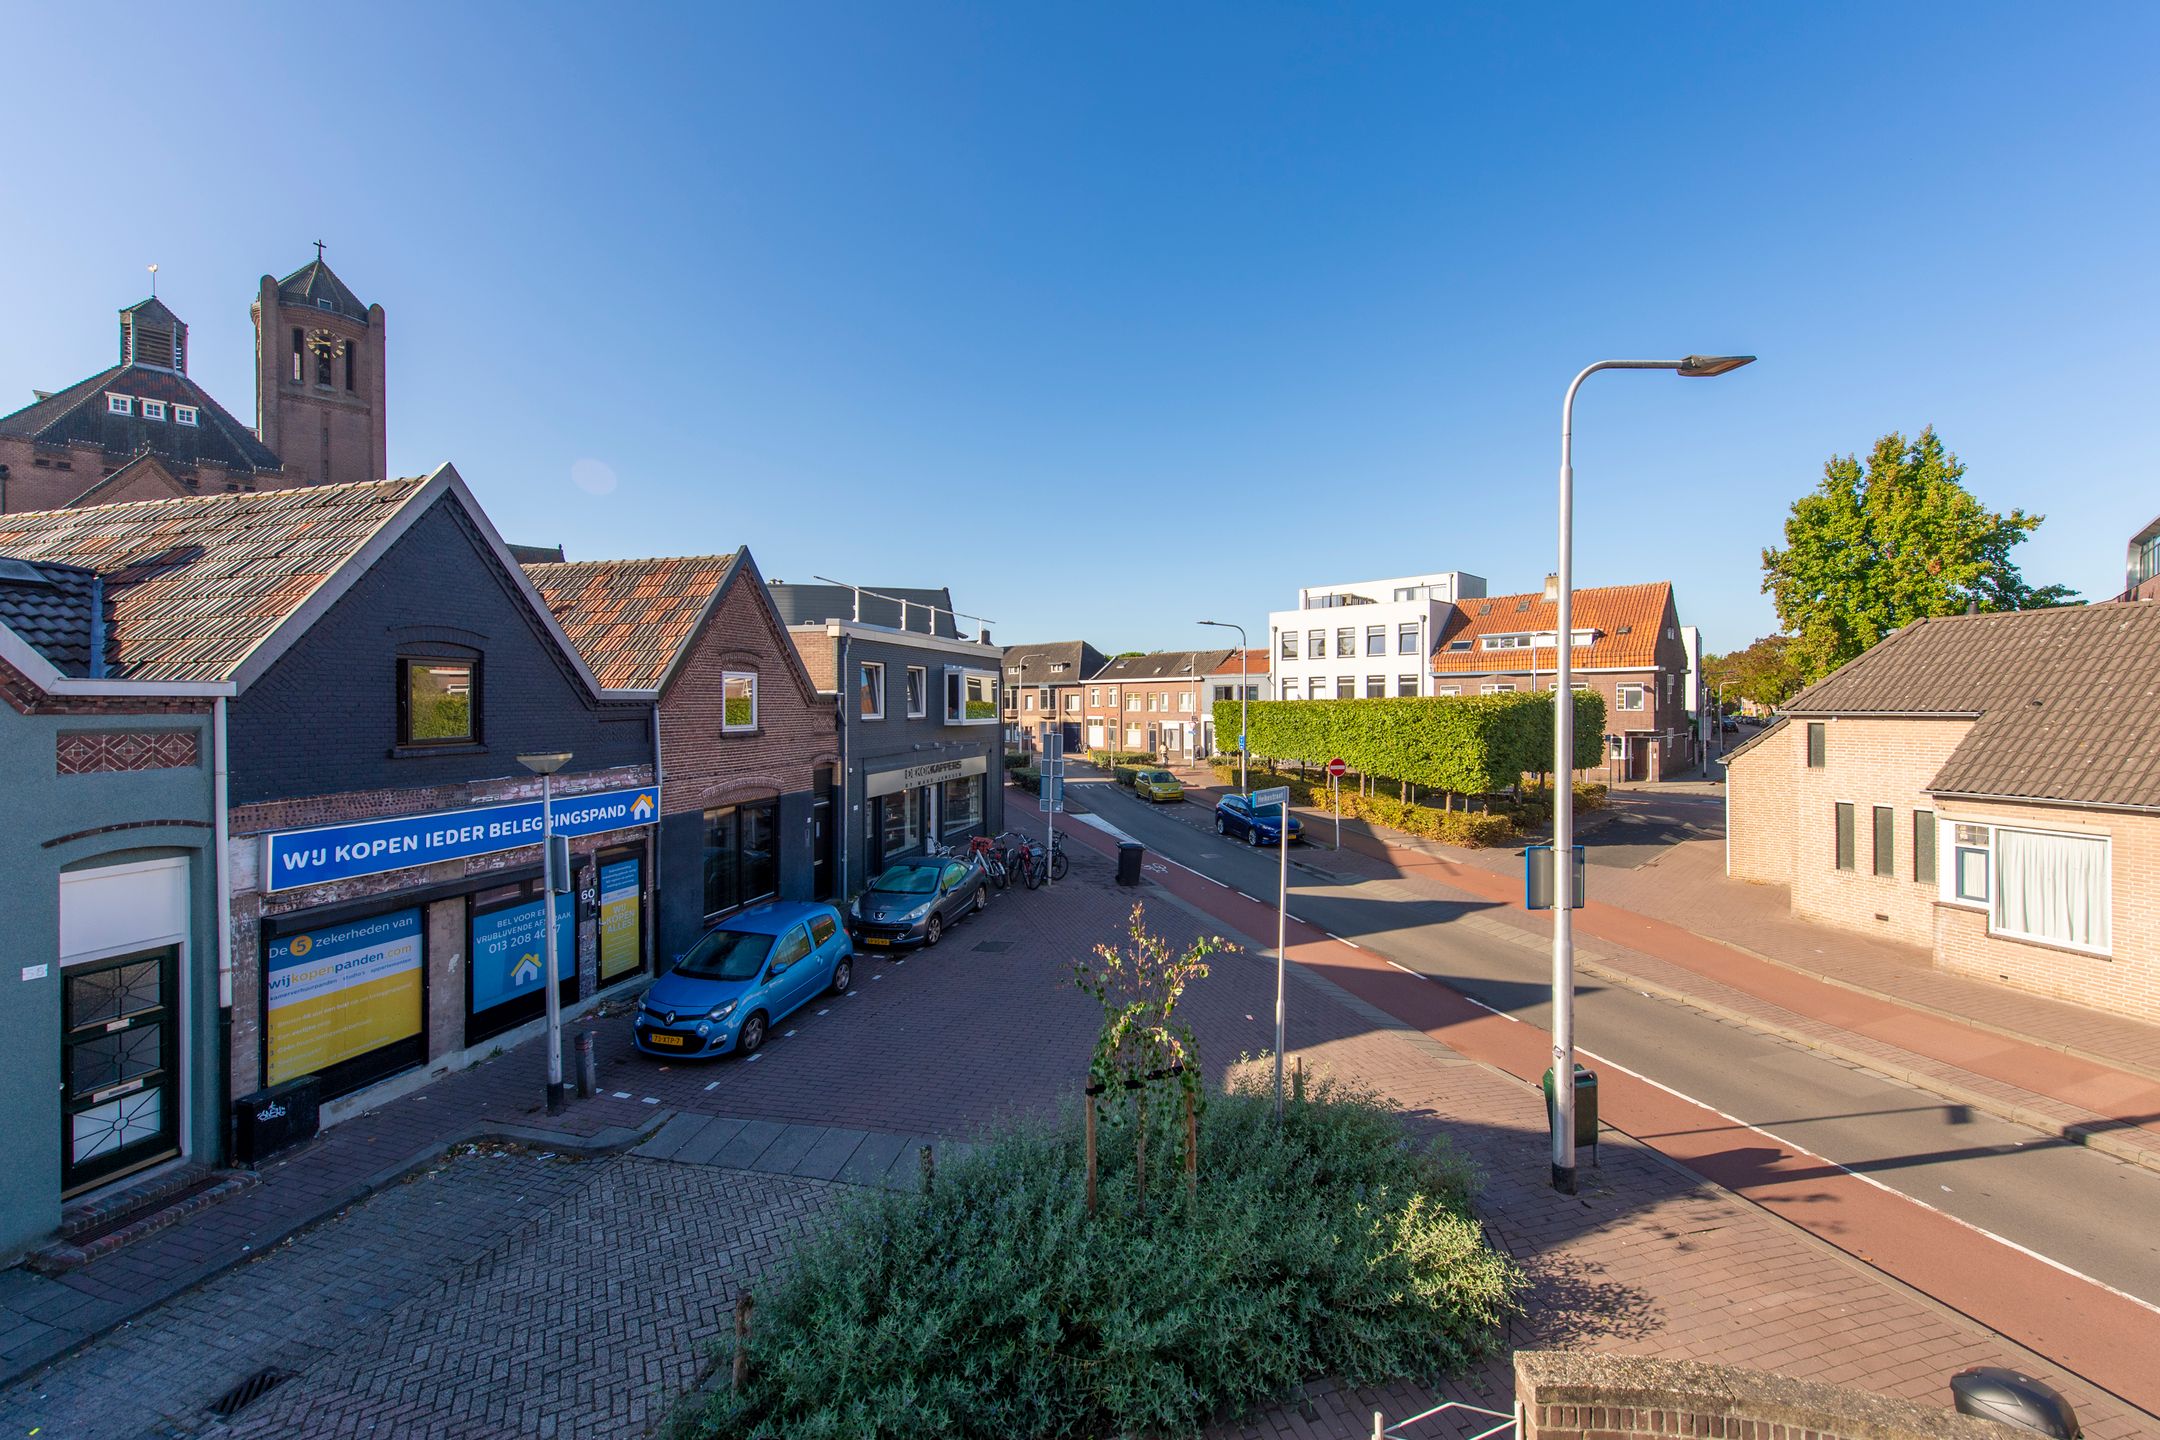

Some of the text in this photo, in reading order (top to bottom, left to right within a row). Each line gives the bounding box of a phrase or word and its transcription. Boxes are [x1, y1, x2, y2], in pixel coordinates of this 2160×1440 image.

[283, 848, 326, 871] WIJ
[335, 834, 418, 863] KOPEN
[425, 826, 485, 848] IEDER
[581, 888, 595, 900] 60
[497, 918, 512, 928] BEL
[513, 911, 536, 922] VOOR
[605, 910, 635, 926] KOPEN
[269, 917, 413, 959] De 5 zekerheden van
[476, 922, 533, 944] VRIJBLIJVENDE
[489, 924, 560, 953] 013 208 407
